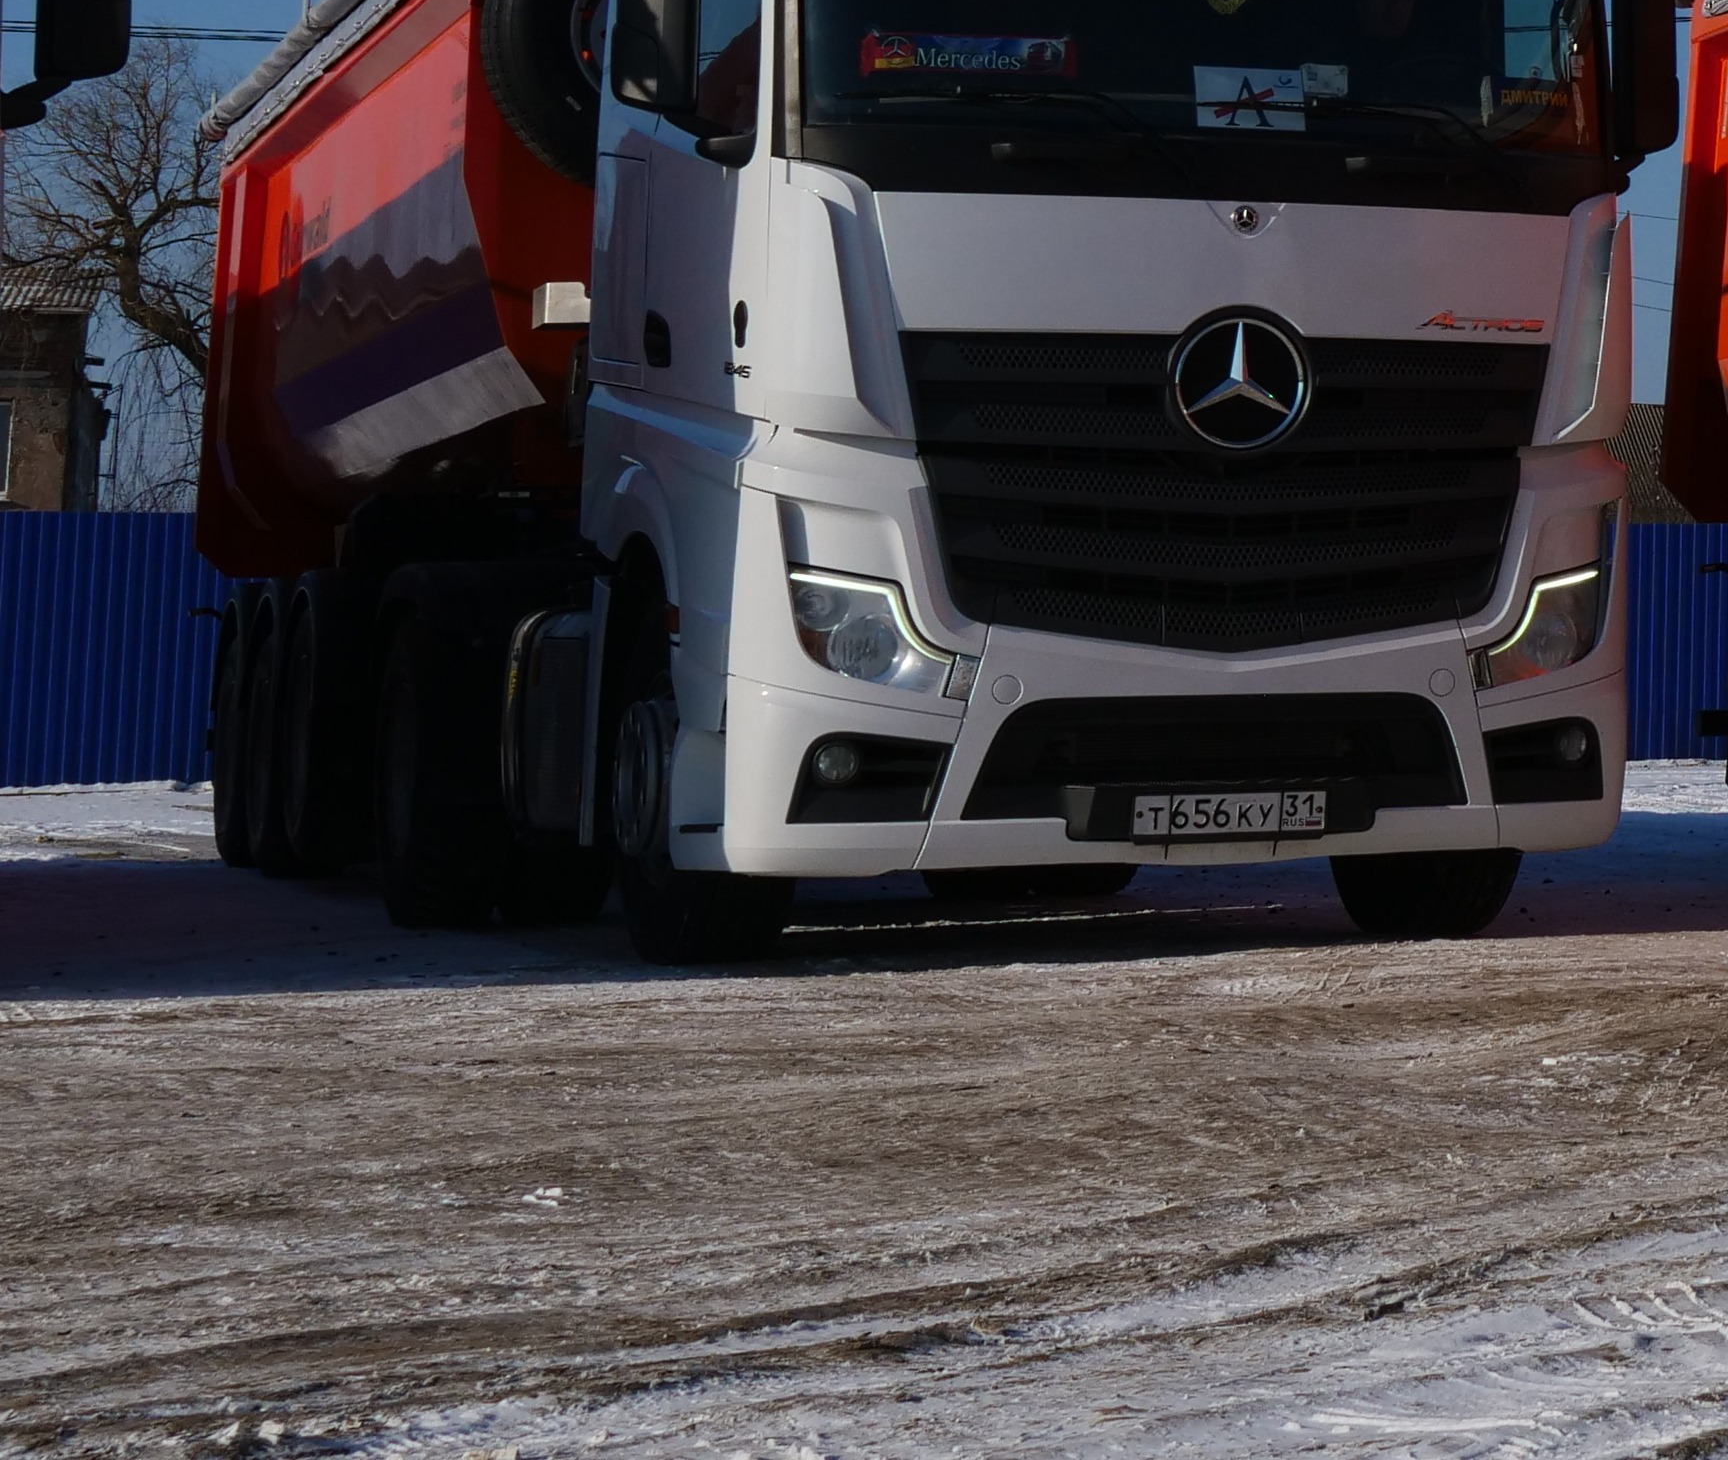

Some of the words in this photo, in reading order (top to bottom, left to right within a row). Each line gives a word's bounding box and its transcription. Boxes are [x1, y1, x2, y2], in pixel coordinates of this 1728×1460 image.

[916, 47, 1021, 70] Mercedes
[1285, 794, 1315, 817] 31
[1281, 817, 1305, 827] RUS
